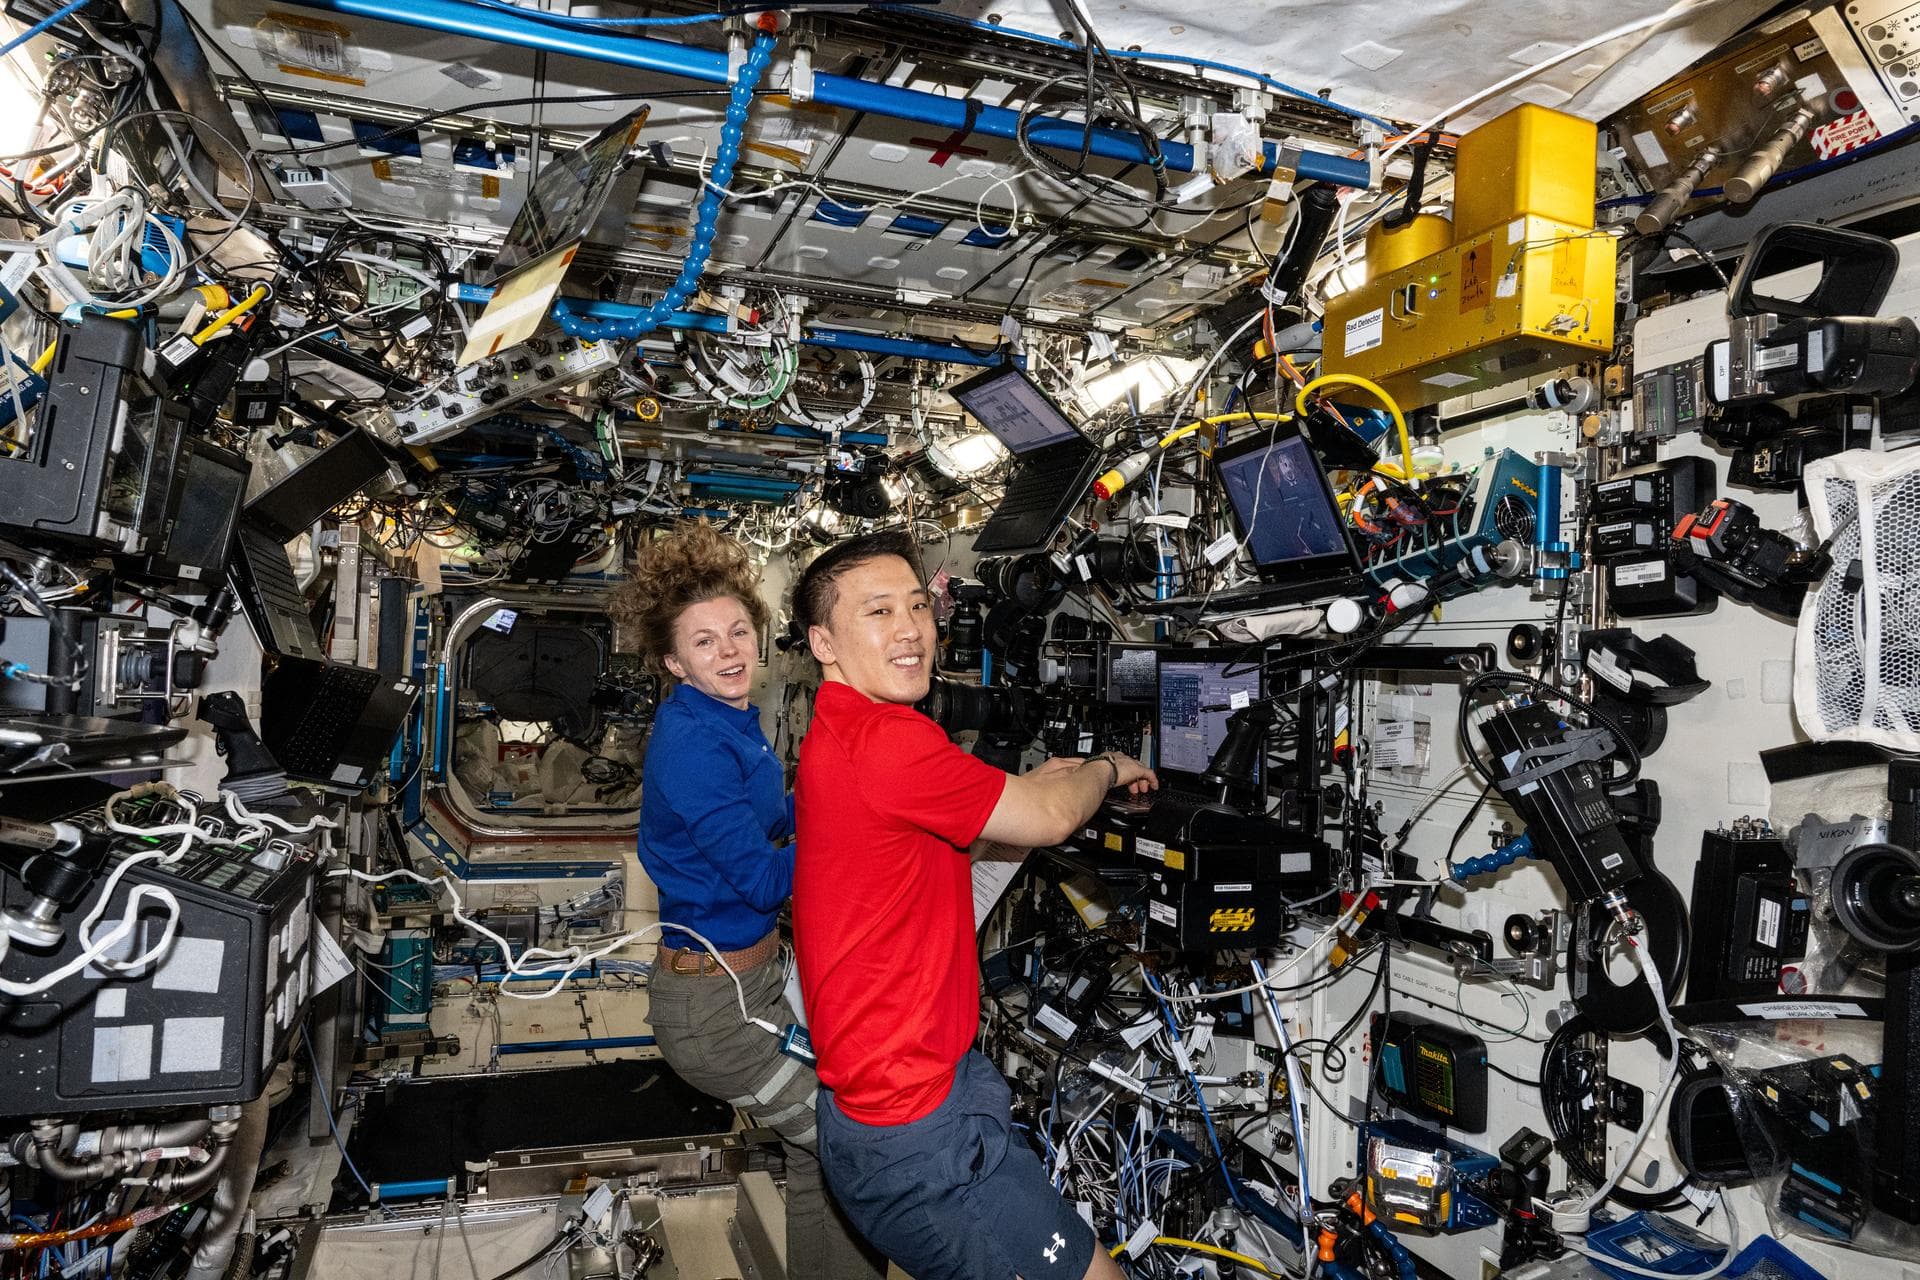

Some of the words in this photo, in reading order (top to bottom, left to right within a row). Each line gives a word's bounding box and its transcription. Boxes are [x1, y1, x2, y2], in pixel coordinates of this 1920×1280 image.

[1830, 132, 1847, 142] FIRE
[1848, 125, 1868, 137] PORT
[1346, 322, 1357, 332] Rad
[1358, 314, 1381, 328] Detector
[1819, 827, 1856, 839] NIKON
